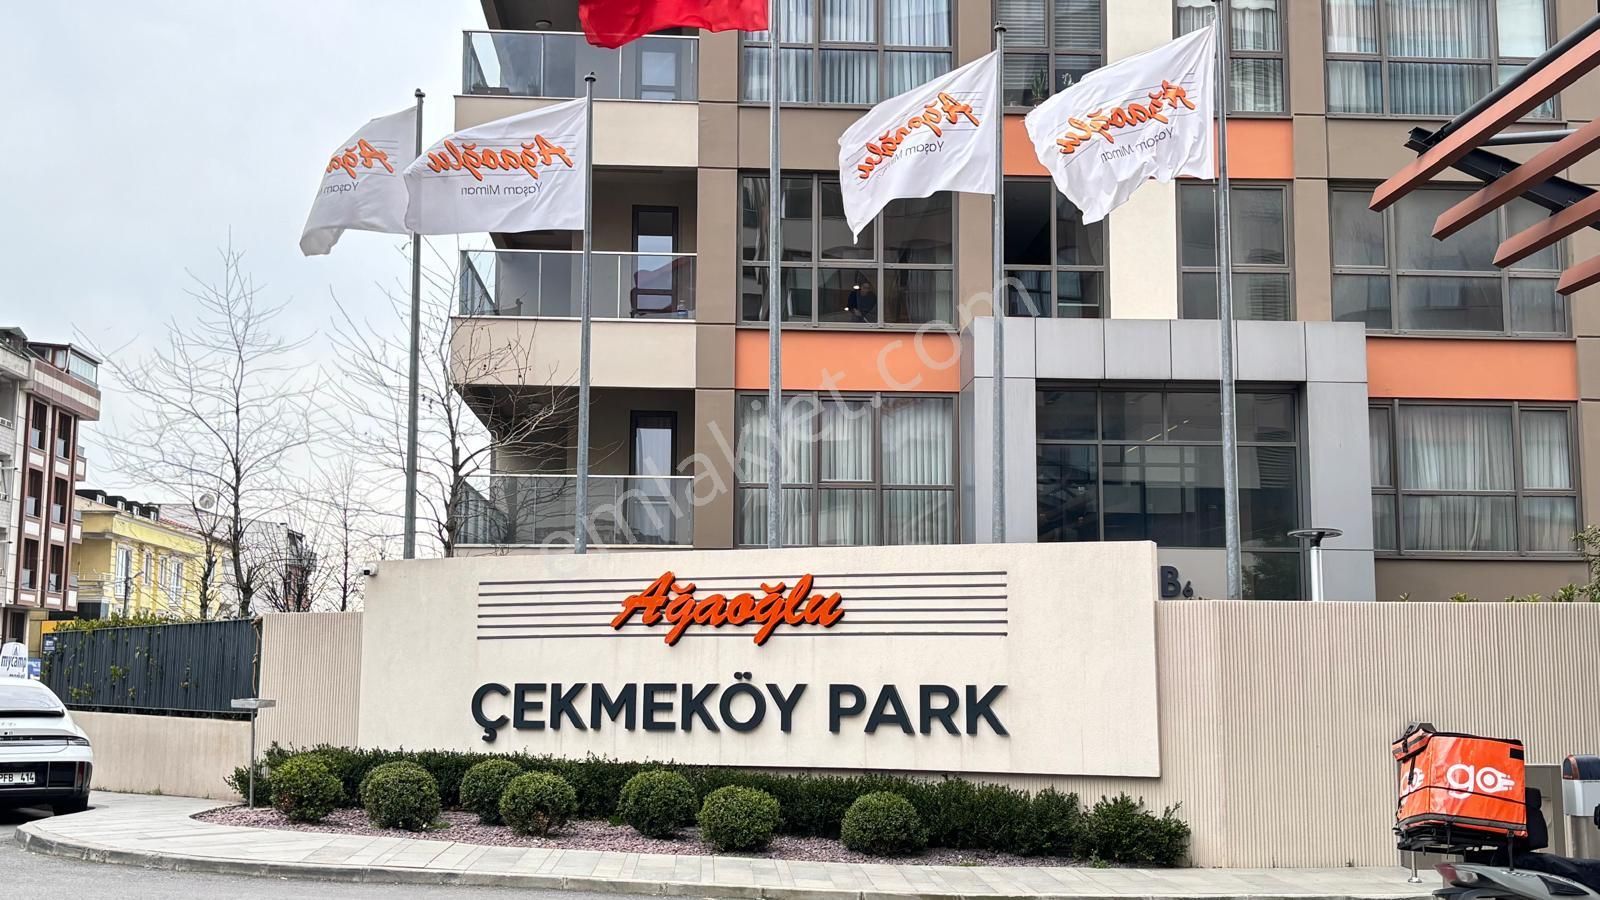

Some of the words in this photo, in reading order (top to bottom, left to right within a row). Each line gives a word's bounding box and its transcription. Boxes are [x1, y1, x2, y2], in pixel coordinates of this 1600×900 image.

[610, 570, 846, 646] Ağaoğlu
[471, 671, 808, 743] ÇEKMEKÖY
[828, 683, 1011, 737] PARK
[20, 771, 35, 782] 414
[1446, 763, 1513, 799] go
